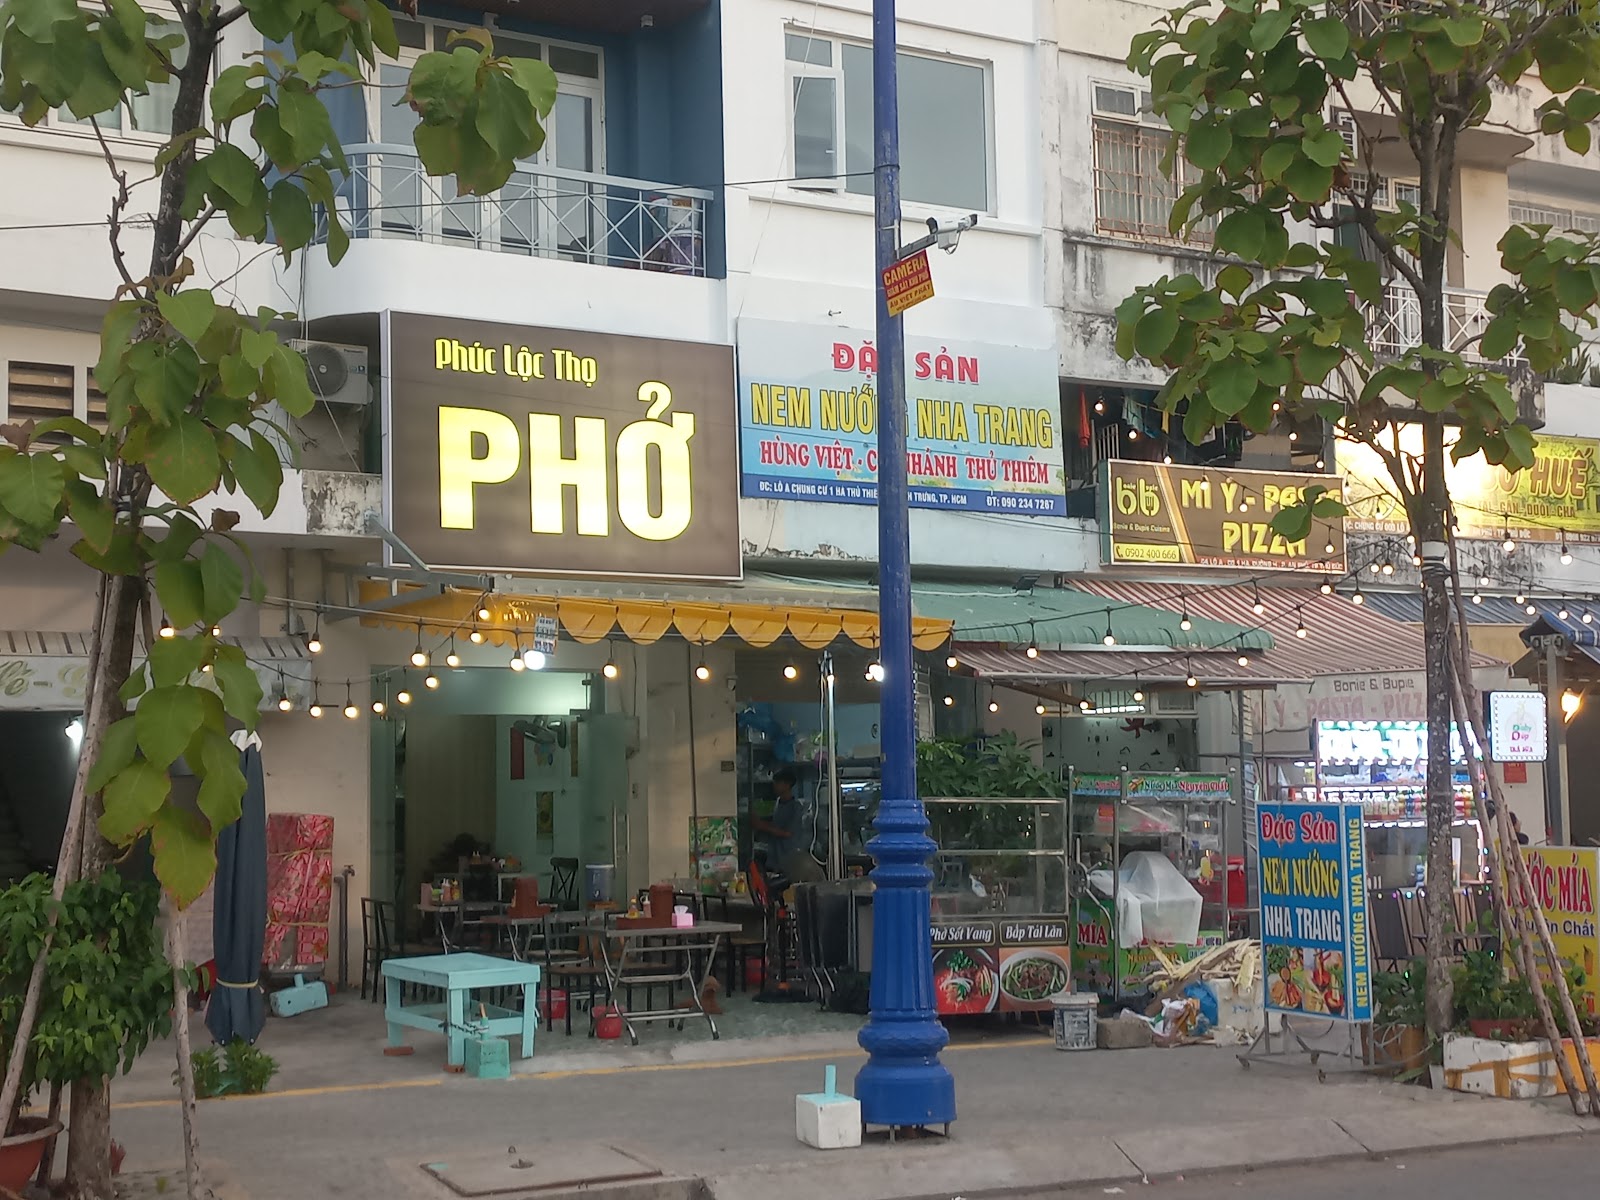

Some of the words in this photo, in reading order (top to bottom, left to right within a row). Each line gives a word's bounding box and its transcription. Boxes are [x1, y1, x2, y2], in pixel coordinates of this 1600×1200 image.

[883, 255, 927, 286] CAMERA
[435, 338, 497, 374] Phúc
[503, 344, 545, 382] Lộc
[552, 349, 598, 388] Thọ
[832, 340, 879, 379] ĐẶ
[914, 346, 979, 385] SẢN
[751, 383, 812, 429] NEM
[917, 398, 970, 442] NHA
[974, 404, 1053, 449] TRANG
[437, 380, 696, 541] PHỞ
[760, 435, 810, 467] HÙNG
[814, 439, 854, 476] VIỆT
[965, 450, 997, 481] THỦ
[1002, 455, 1049, 484] THIÊM
[1529, 447, 1594, 500] HUẾ
[791, 483, 816, 495] CHUNG
[1001, 496, 1017, 508] 090
[1018, 498, 1033, 509] 234
[1125, 547, 1144, 558] 0902
[1146, 548, 1160, 559] 400
[1161, 549, 1177, 560] 666
[1370, 679, 1379, 690] &
[1306, 695, 1364, 725] PASTA
[1349, 817, 1362, 871] TRANG
[1262, 857, 1290, 896] NEM
[1292, 848, 1340, 899] NƯỚNG
[1352, 873, 1364, 908] NHA
[1557, 852, 1593, 913] MÍA
[966, 926, 993, 943] Vang
[1076, 920, 1108, 946] MÍA
[1264, 904, 1293, 938] NHA
[1295, 906, 1342, 943] TRANG
[1350, 911, 1367, 967] NƯỚNG
[1563, 918, 1595, 937] Chất
[1356, 971, 1368, 1008] NEM
